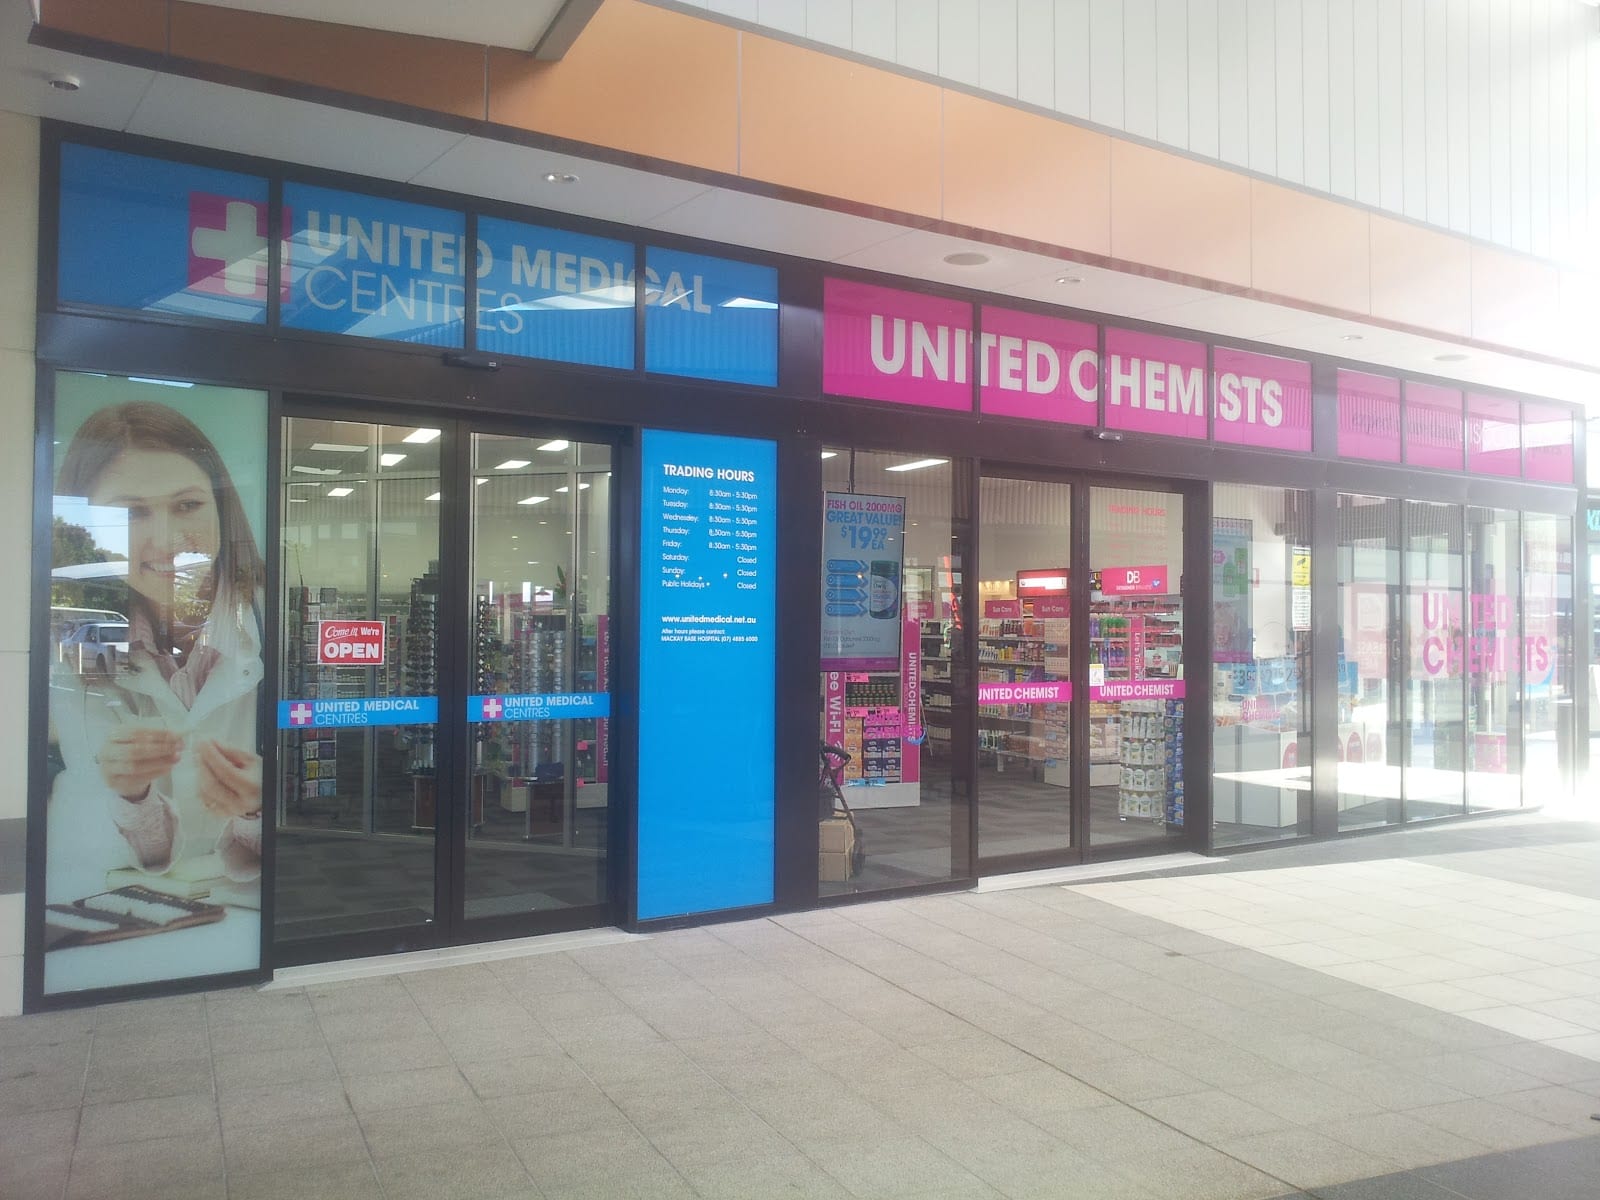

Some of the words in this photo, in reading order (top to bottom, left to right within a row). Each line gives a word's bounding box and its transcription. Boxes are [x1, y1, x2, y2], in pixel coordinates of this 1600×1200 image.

[307, 210, 493, 279] UNITED
[511, 245, 712, 315] MEDICAL
[305, 265, 523, 335] CENTRES
[870, 314, 1060, 395] UNITED
[1069, 348, 1283, 428] CHEMSTS
[663, 463, 714, 479] TRADING
[717, 468, 755, 482] HOURS
[827, 500, 846, 510] FISH
[849, 501, 864, 510] OIL
[866, 502, 903, 513] 2000MG
[827, 511, 863, 524] GREAT
[737, 556, 757, 564] Closed
[737, 569, 757, 577] Closed
[1127, 570, 1141, 584] DB
[737, 582, 757, 590] Closed
[1423, 592, 1513, 630] UNTED
[325, 626, 349, 639] Come
[324, 642, 379, 659] OPEN
[908, 652, 917, 689] UNITED
[1014, 687, 1059, 699] CHEMIST
[1100, 685, 1133, 697] UNITED
[1134, 684, 1174, 696] CHEMIST
[315, 701, 360, 713] UNITED
[364, 699, 419, 712] MEDICAL
[505, 696, 544, 707] UNITED
[546, 694, 594, 706] MEDICAL
[315, 713, 368, 725] CENTRES
[504, 706, 550, 719] CENTRES
